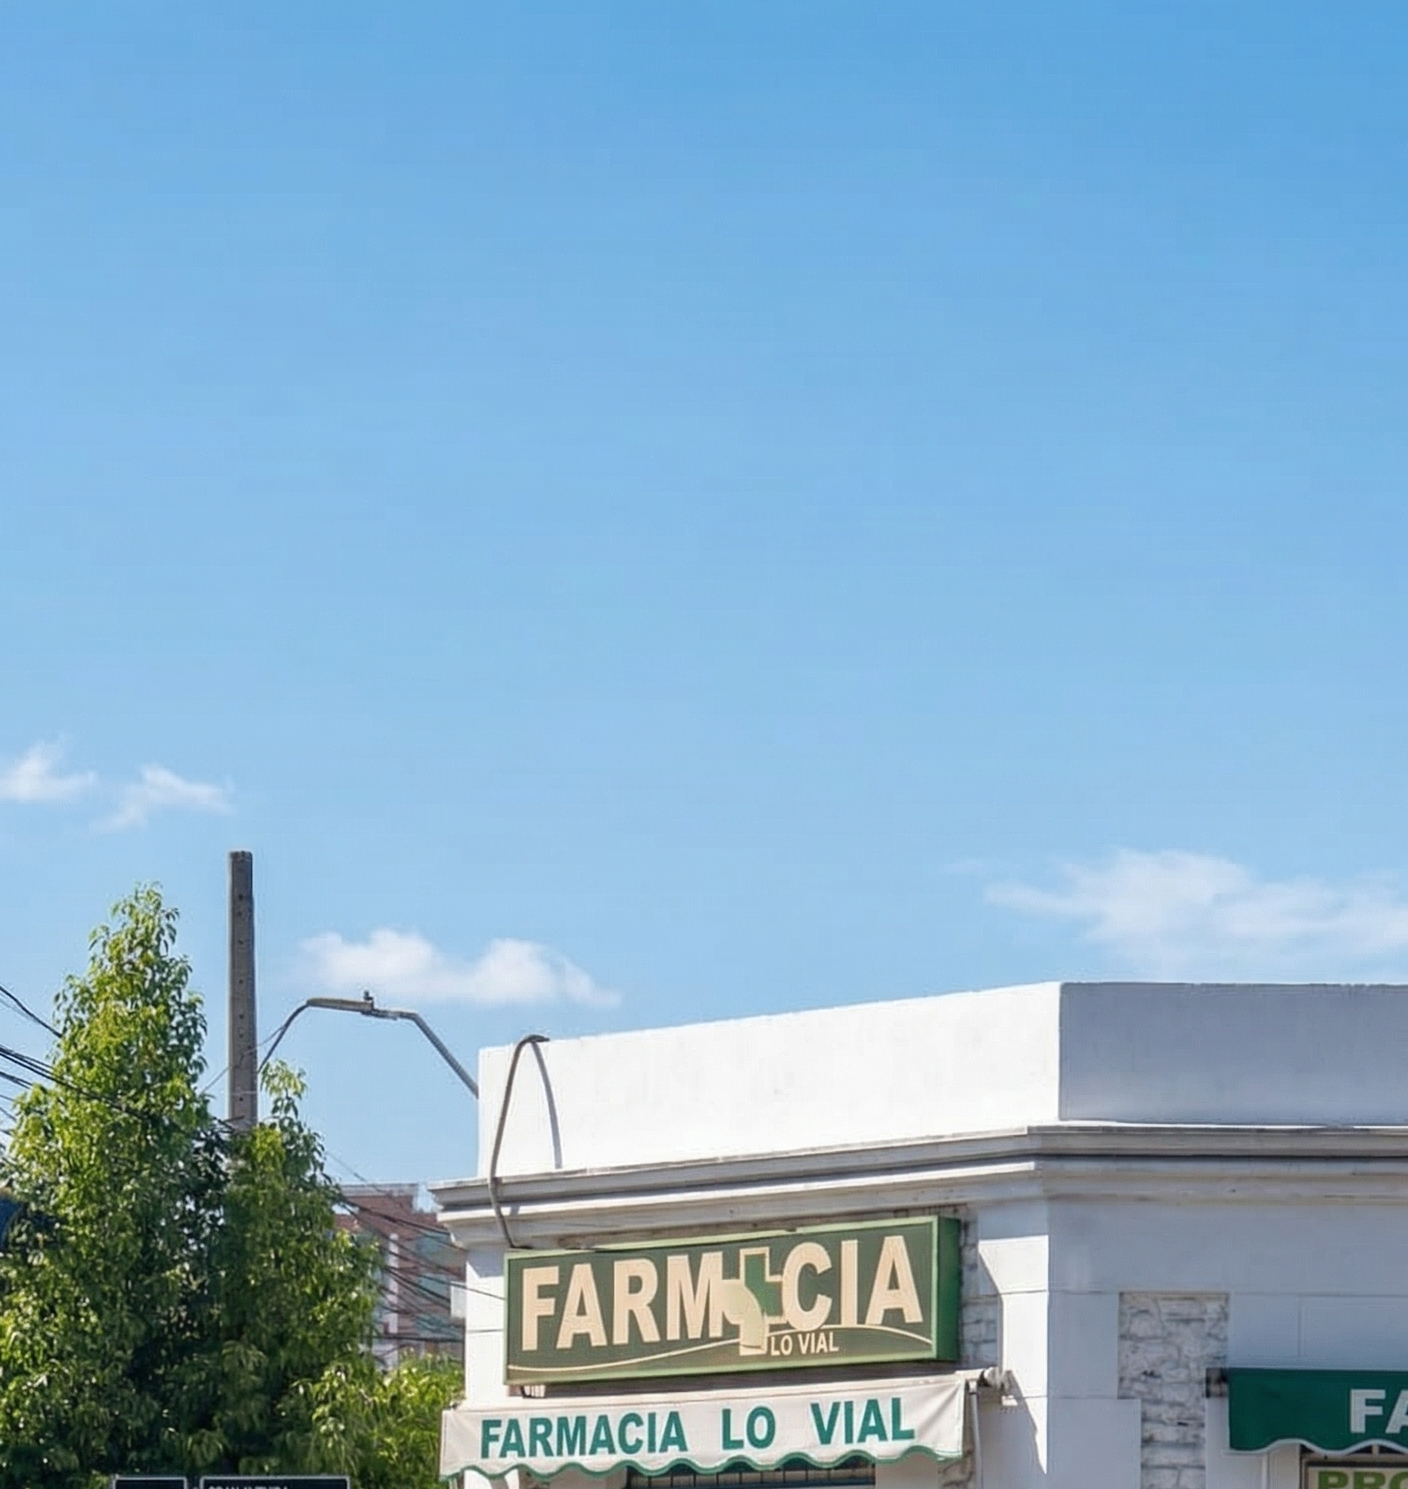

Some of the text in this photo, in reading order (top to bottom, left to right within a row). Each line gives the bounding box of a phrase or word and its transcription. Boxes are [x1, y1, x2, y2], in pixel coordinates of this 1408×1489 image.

[521, 1234, 923, 1352] FARMCIA
[771, 1331, 840, 1356] LO VIAL
[480, 1397, 916, 1459] FARMACIA LO VIAL
